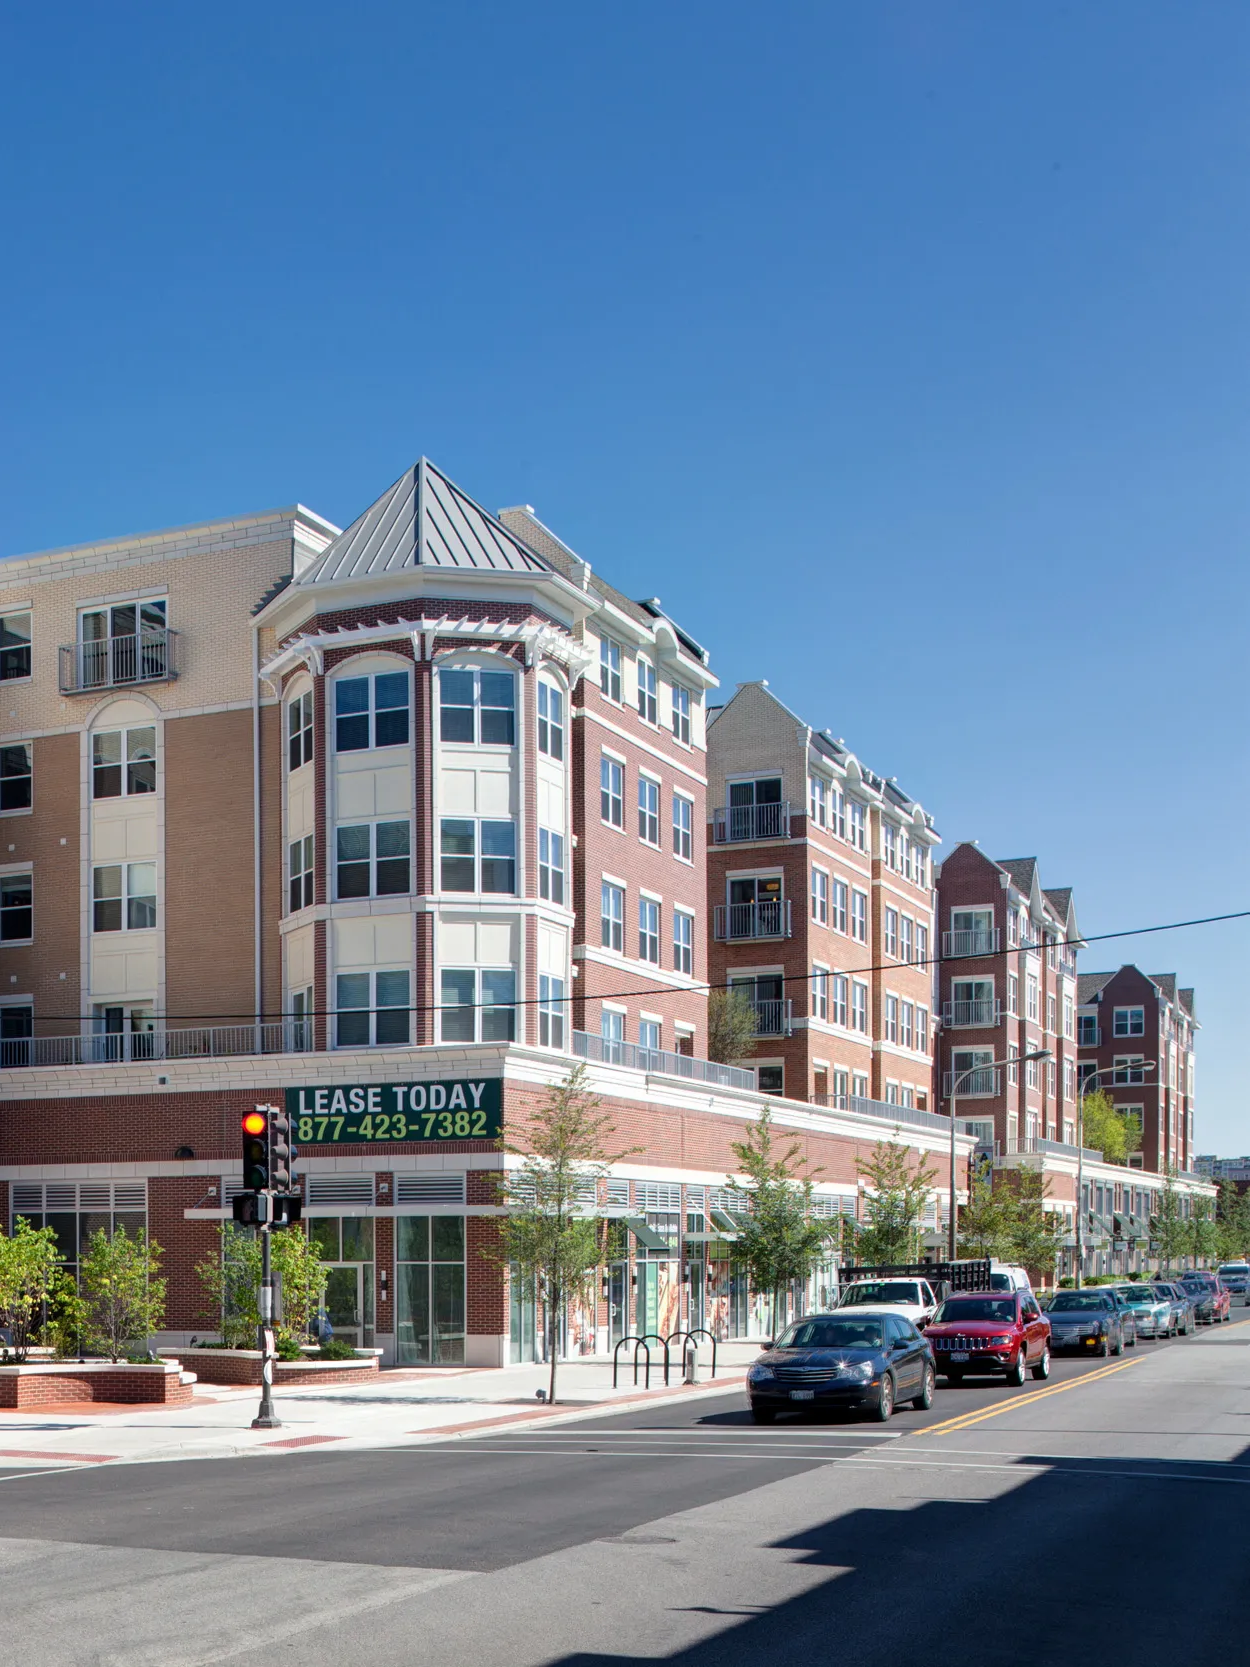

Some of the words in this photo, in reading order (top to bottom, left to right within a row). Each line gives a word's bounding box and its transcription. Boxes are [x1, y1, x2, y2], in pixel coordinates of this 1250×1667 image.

[299, 1087, 382, 1115] LEASE
[392, 1083, 486, 1111] TODAY
[299, 1111, 487, 1141] 877-423-7382
